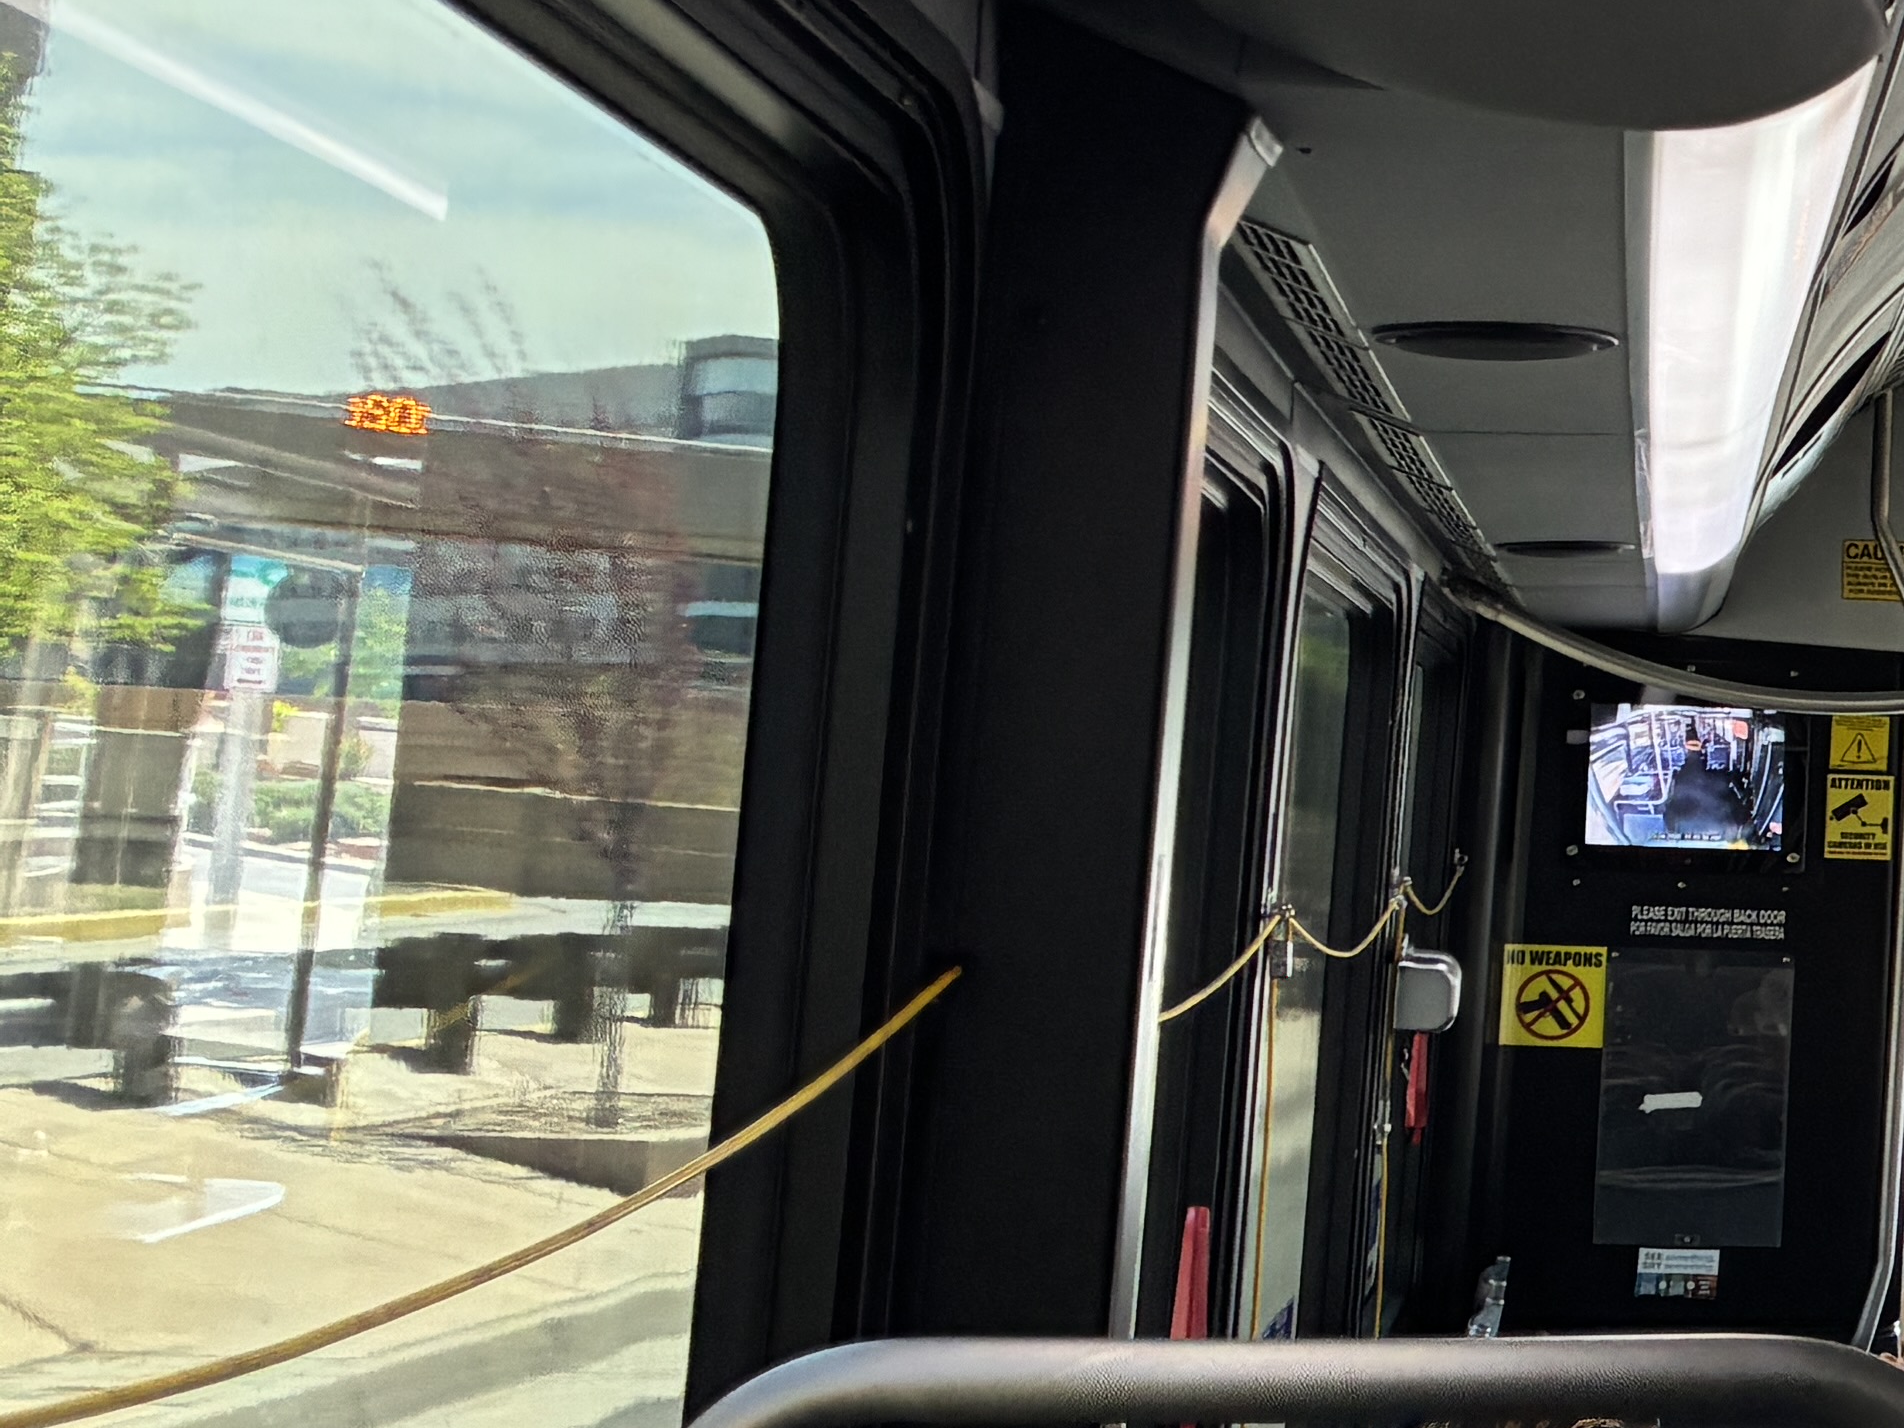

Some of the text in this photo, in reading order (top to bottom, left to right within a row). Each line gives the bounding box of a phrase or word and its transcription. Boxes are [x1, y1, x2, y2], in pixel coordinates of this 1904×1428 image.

[1830, 777, 1890, 790] ATTENTION
[1631, 905, 1786, 924] PLEASE EXIT THROUGH BACK DOOR
[1507, 950, 1603, 968] NO WEAPONS
